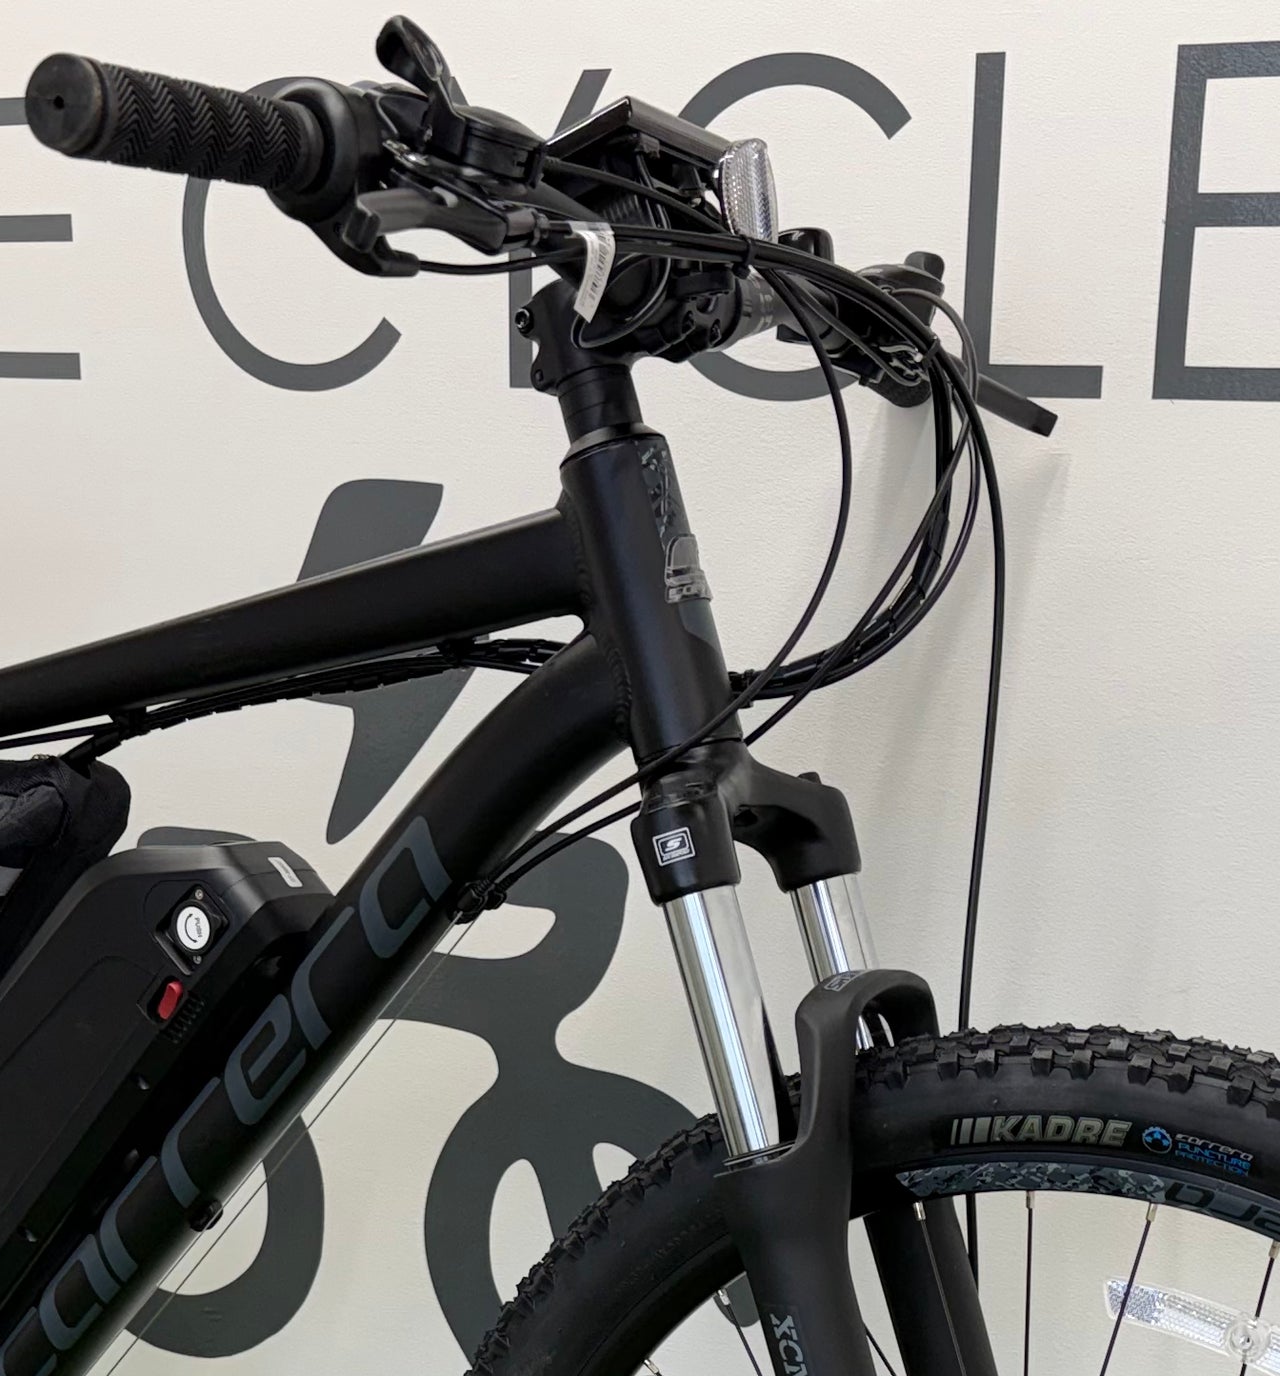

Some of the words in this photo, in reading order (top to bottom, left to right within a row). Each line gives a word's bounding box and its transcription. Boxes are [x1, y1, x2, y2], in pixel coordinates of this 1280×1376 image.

[1175, 1132, 1255, 1161] carrera
[1177, 1142, 1251, 1170] PUNCTURE
[1174, 1149, 1250, 1177] PROTECTION
